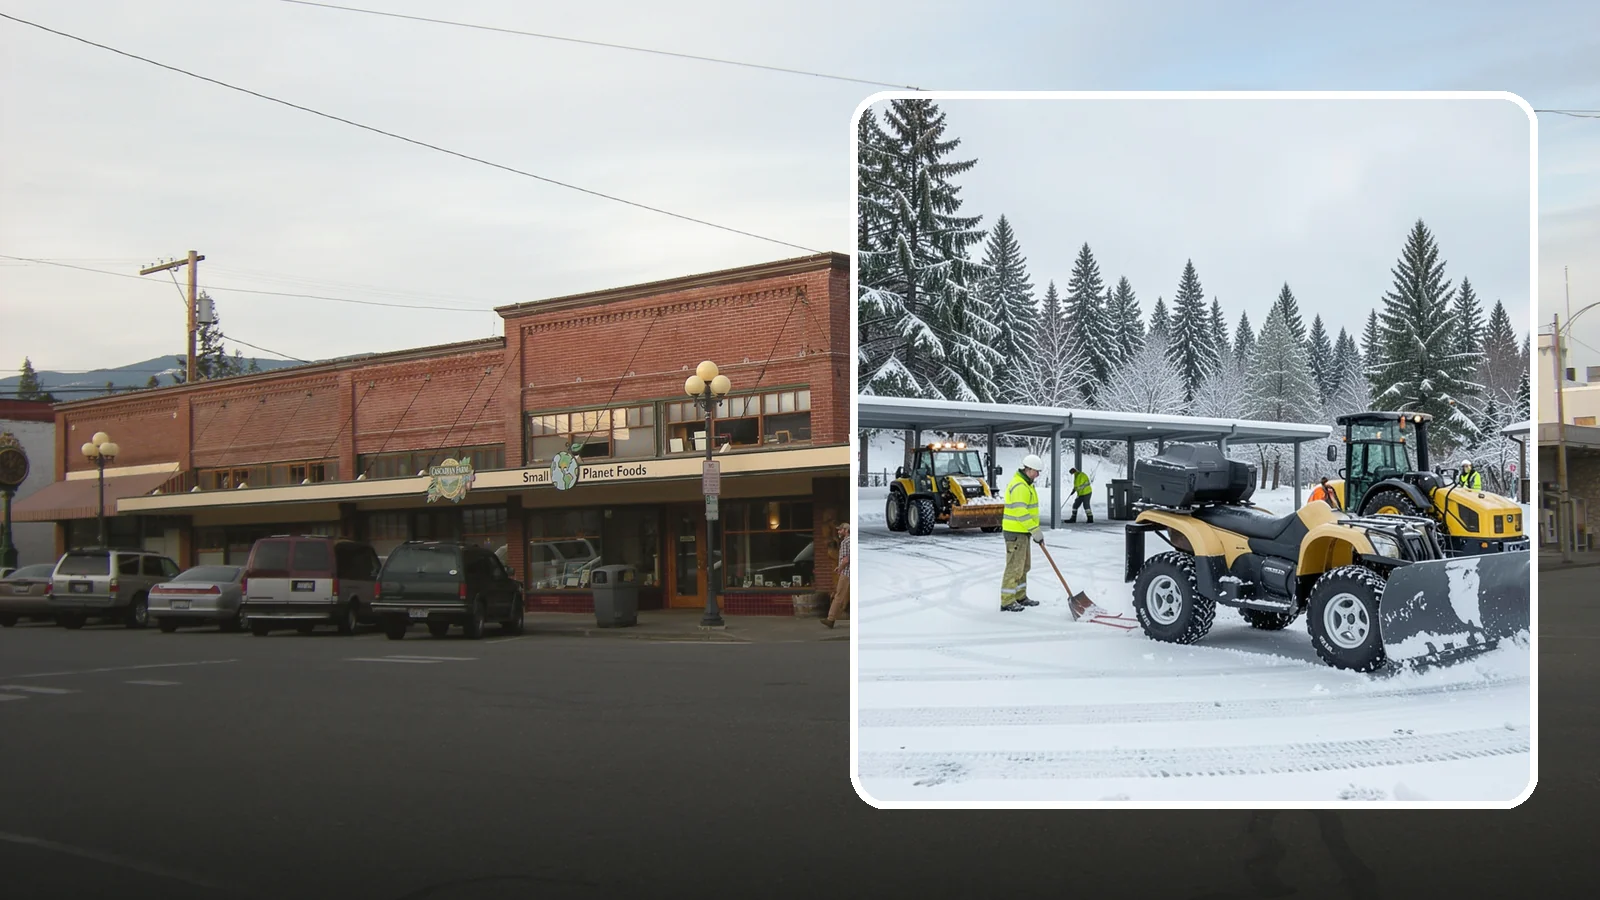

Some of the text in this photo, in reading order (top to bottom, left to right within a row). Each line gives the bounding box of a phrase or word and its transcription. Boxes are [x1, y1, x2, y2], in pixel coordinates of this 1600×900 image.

[523, 464, 647, 483] Small Planet Foods
